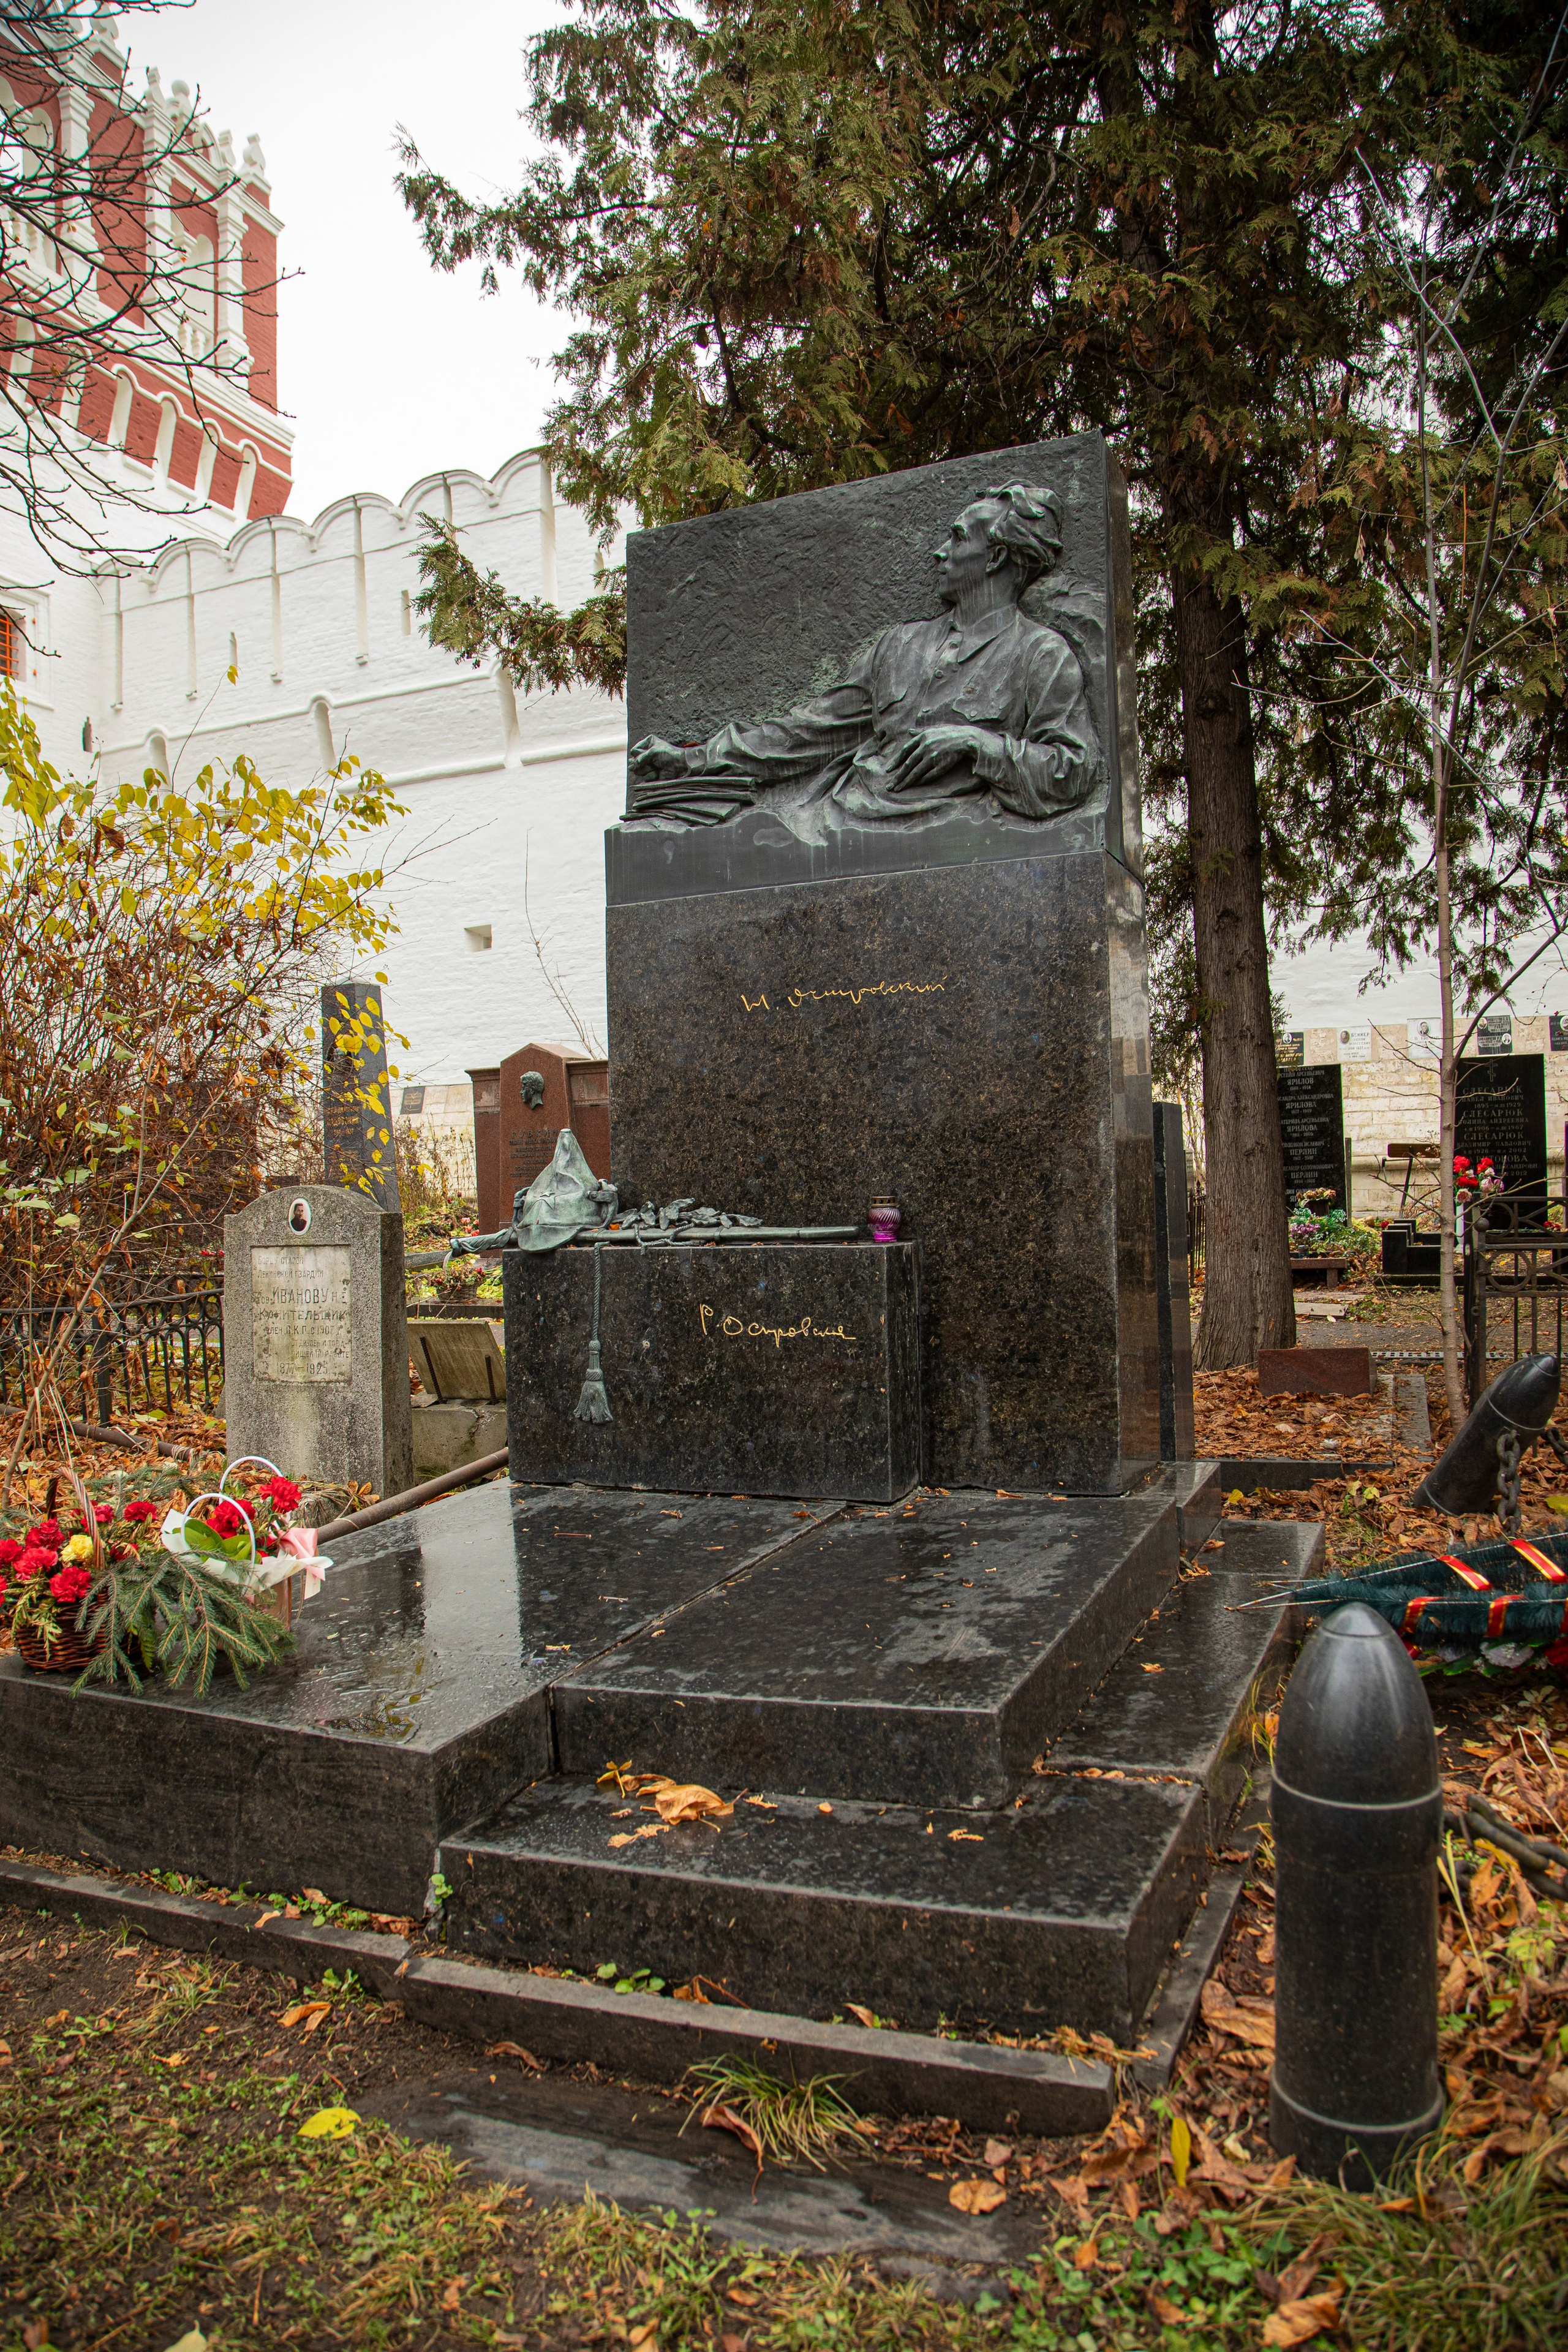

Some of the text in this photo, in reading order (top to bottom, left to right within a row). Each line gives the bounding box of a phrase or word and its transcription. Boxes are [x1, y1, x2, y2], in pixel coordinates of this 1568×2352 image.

[1463, 1109, 1523, 1118] СЛЕСАРЮК
[1464, 1131, 1523, 1140] СЛЕСАРЮК
[273, 1286, 329, 1304] ИВАНОВУ
[277, 1363, 295, 1374] 1877
[306, 1362, 328, 1374] 1925
